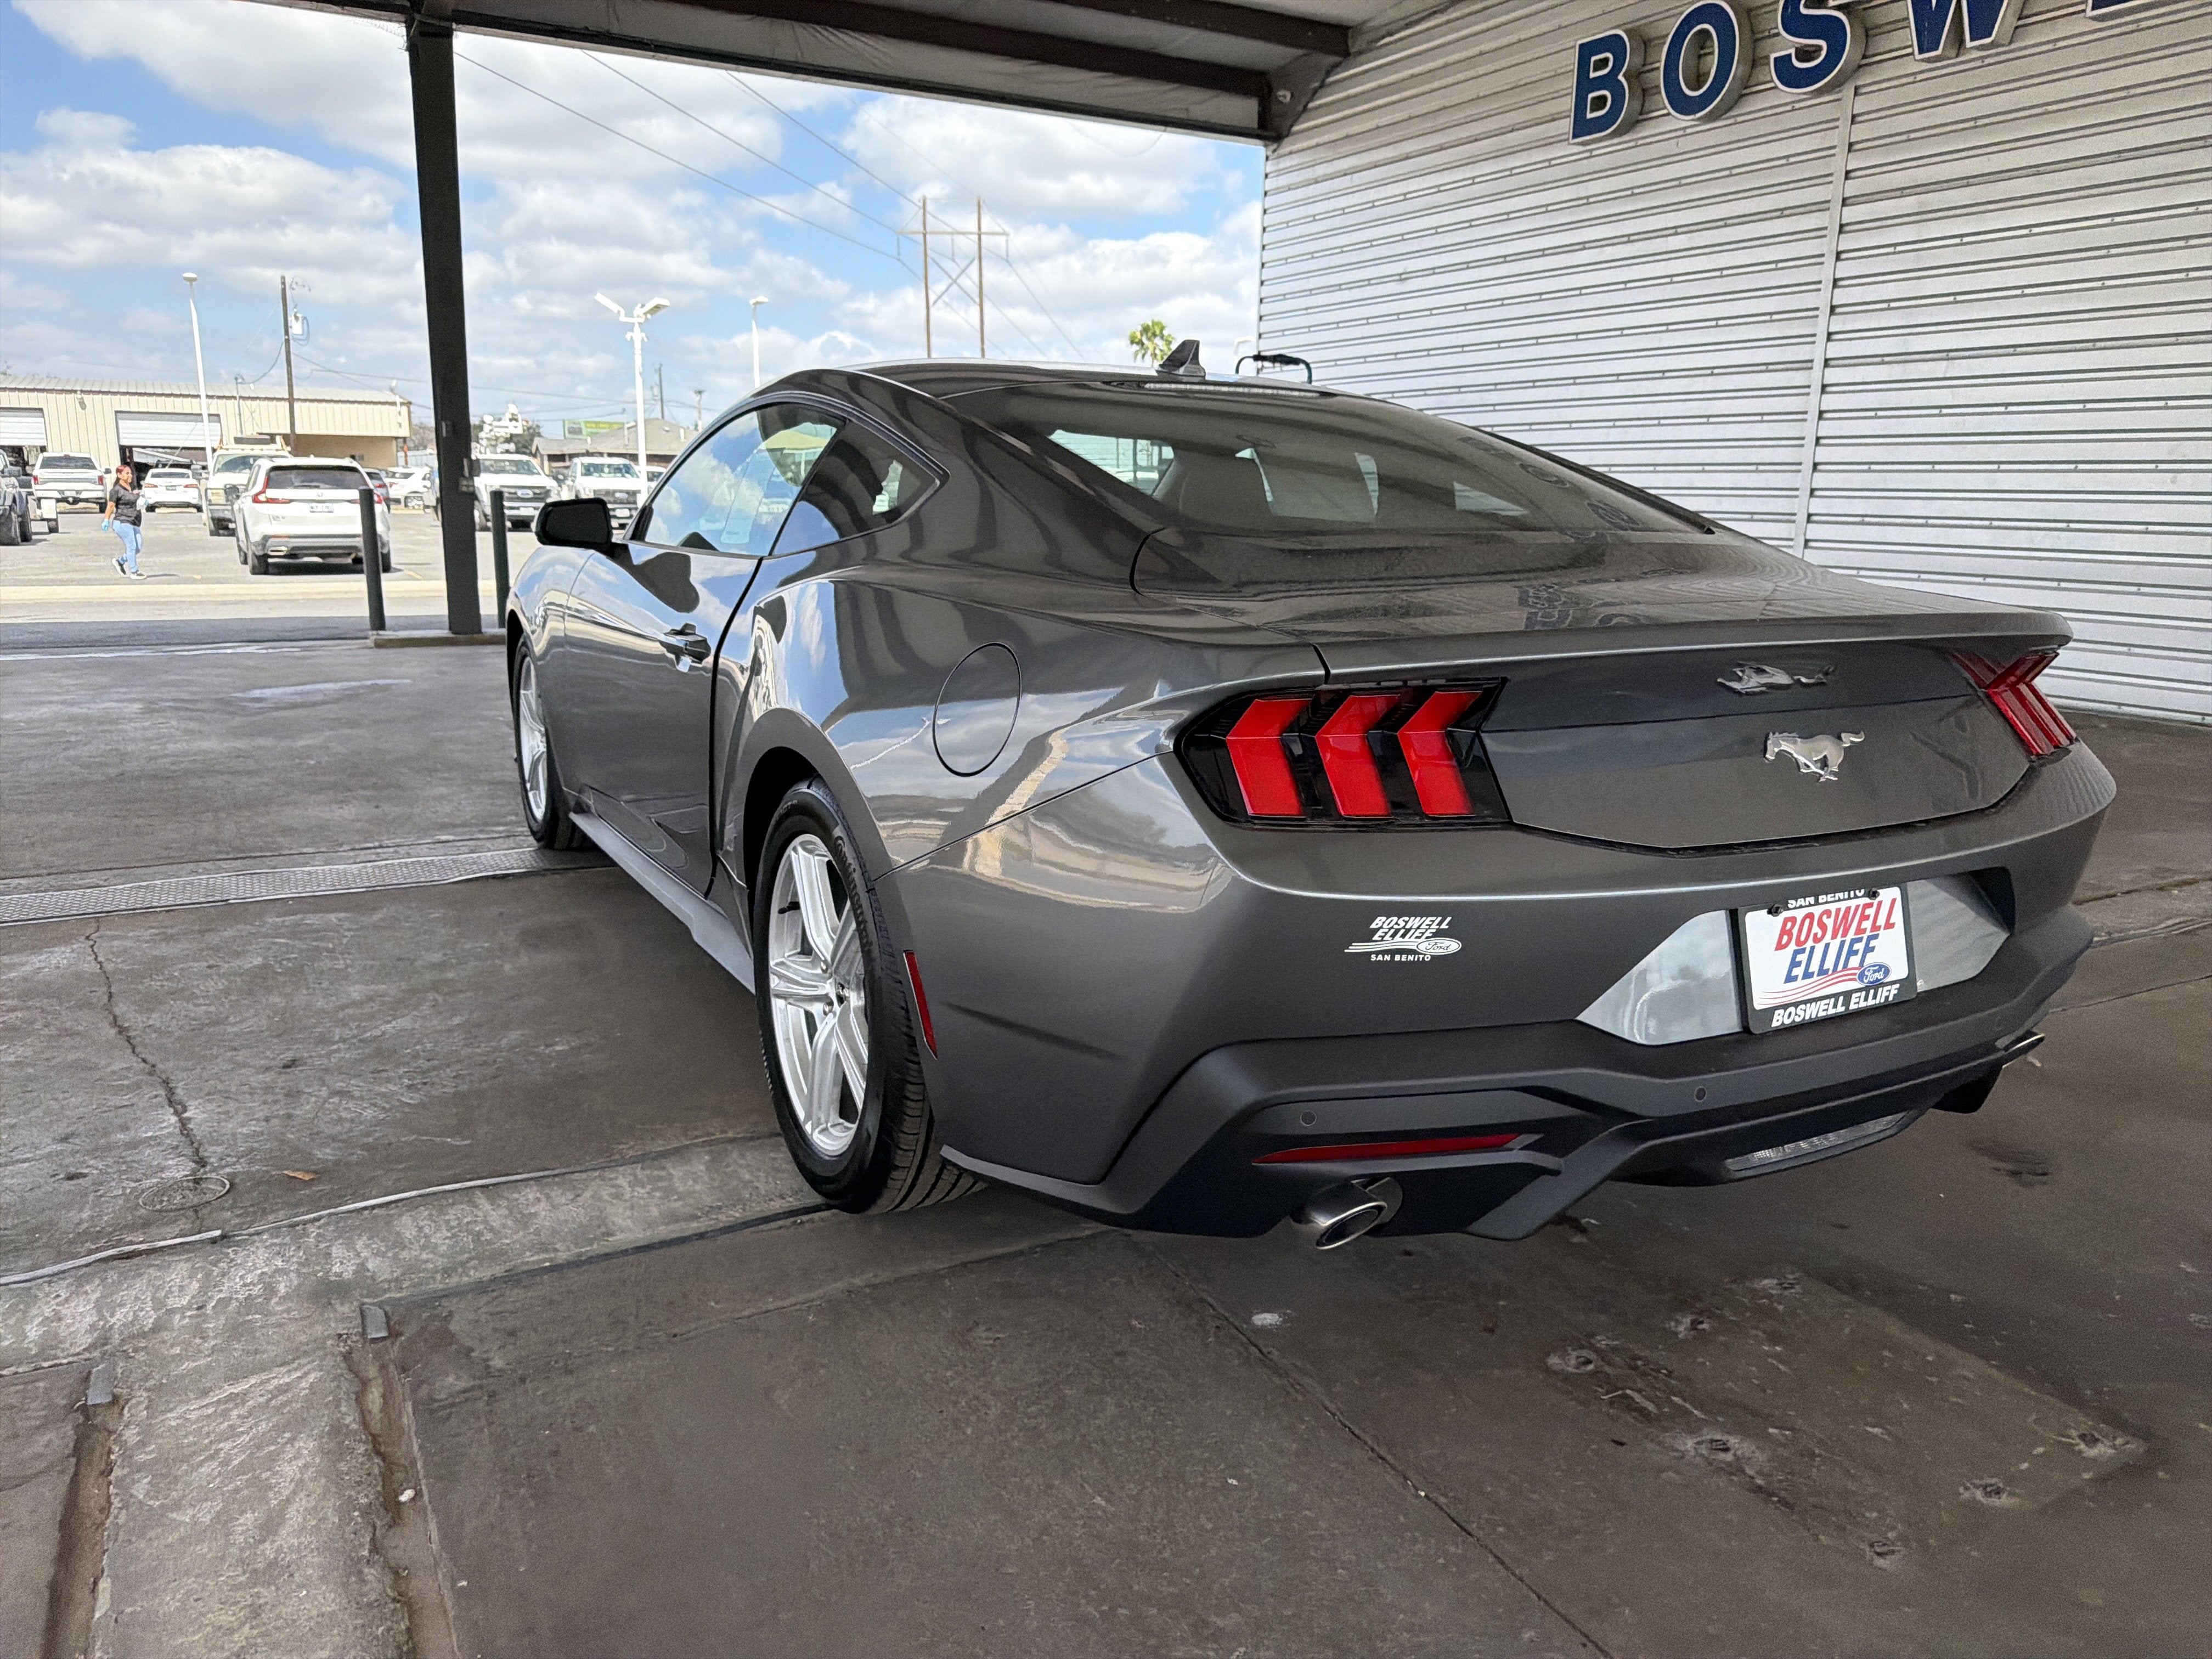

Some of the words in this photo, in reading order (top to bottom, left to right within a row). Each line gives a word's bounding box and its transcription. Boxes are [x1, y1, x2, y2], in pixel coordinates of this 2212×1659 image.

[1369, 916, 1452, 929] BOSWELL
[1372, 929, 1437, 941] ELLIFF
[1774, 898, 1898, 951] BOSWELL
[1783, 933, 1880, 984] ELLIFF
[1771, 996, 1846, 1028] BOSWELL
[1849, 984, 1900, 1009] ELLIFF
